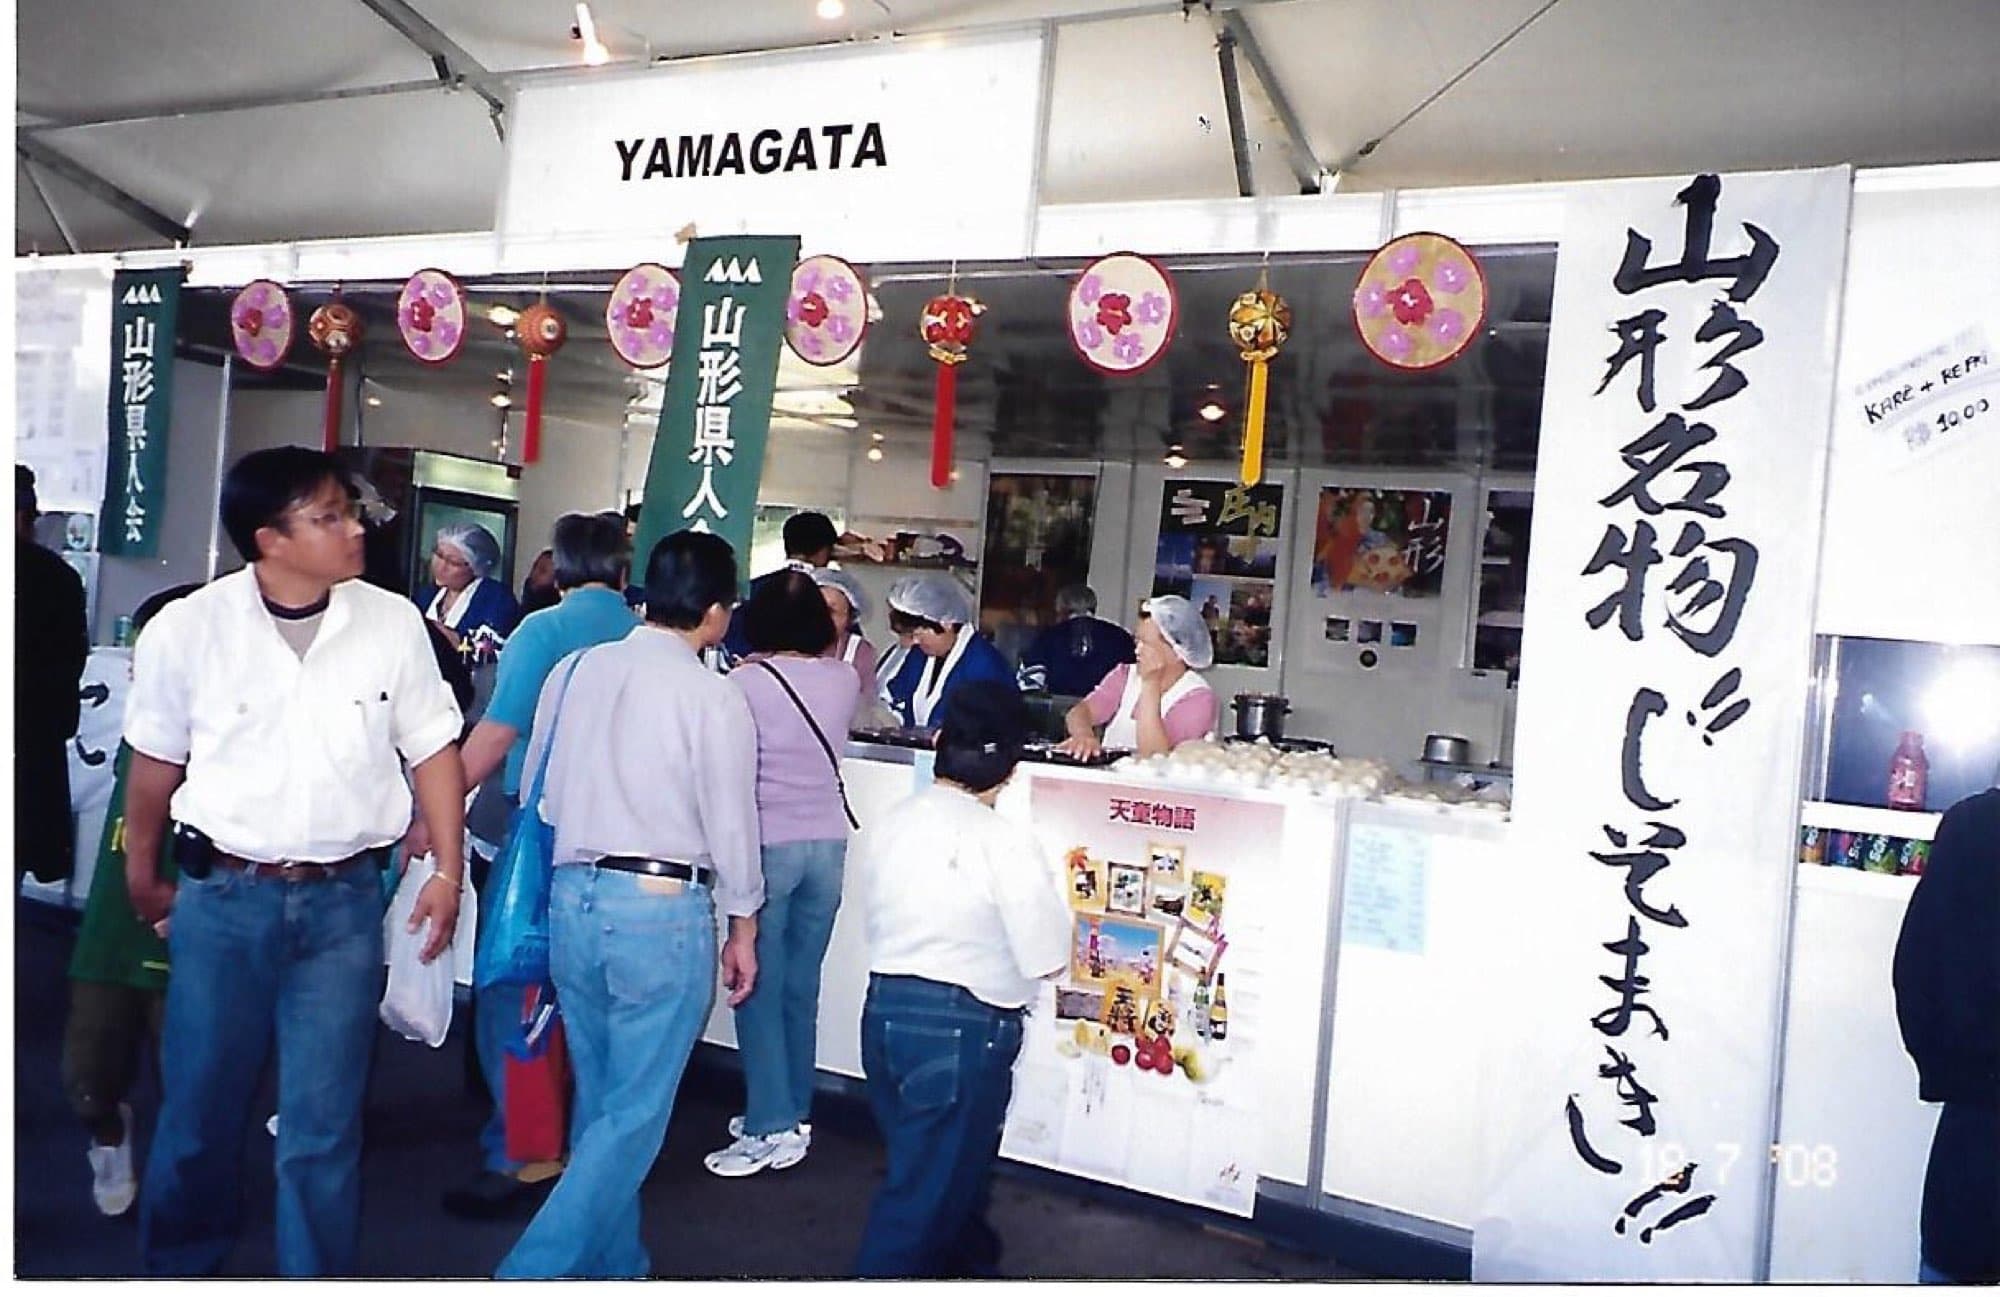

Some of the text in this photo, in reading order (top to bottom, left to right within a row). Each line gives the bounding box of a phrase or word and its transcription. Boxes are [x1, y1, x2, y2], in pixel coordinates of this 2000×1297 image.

[614, 122, 888, 182] YAMAGATA
[121, 315, 157, 545] 山形県人会
[682, 296, 747, 535] 山形県人
[1402, 498, 1445, 574] 山形
[1108, 797, 1197, 832] 天童物語
